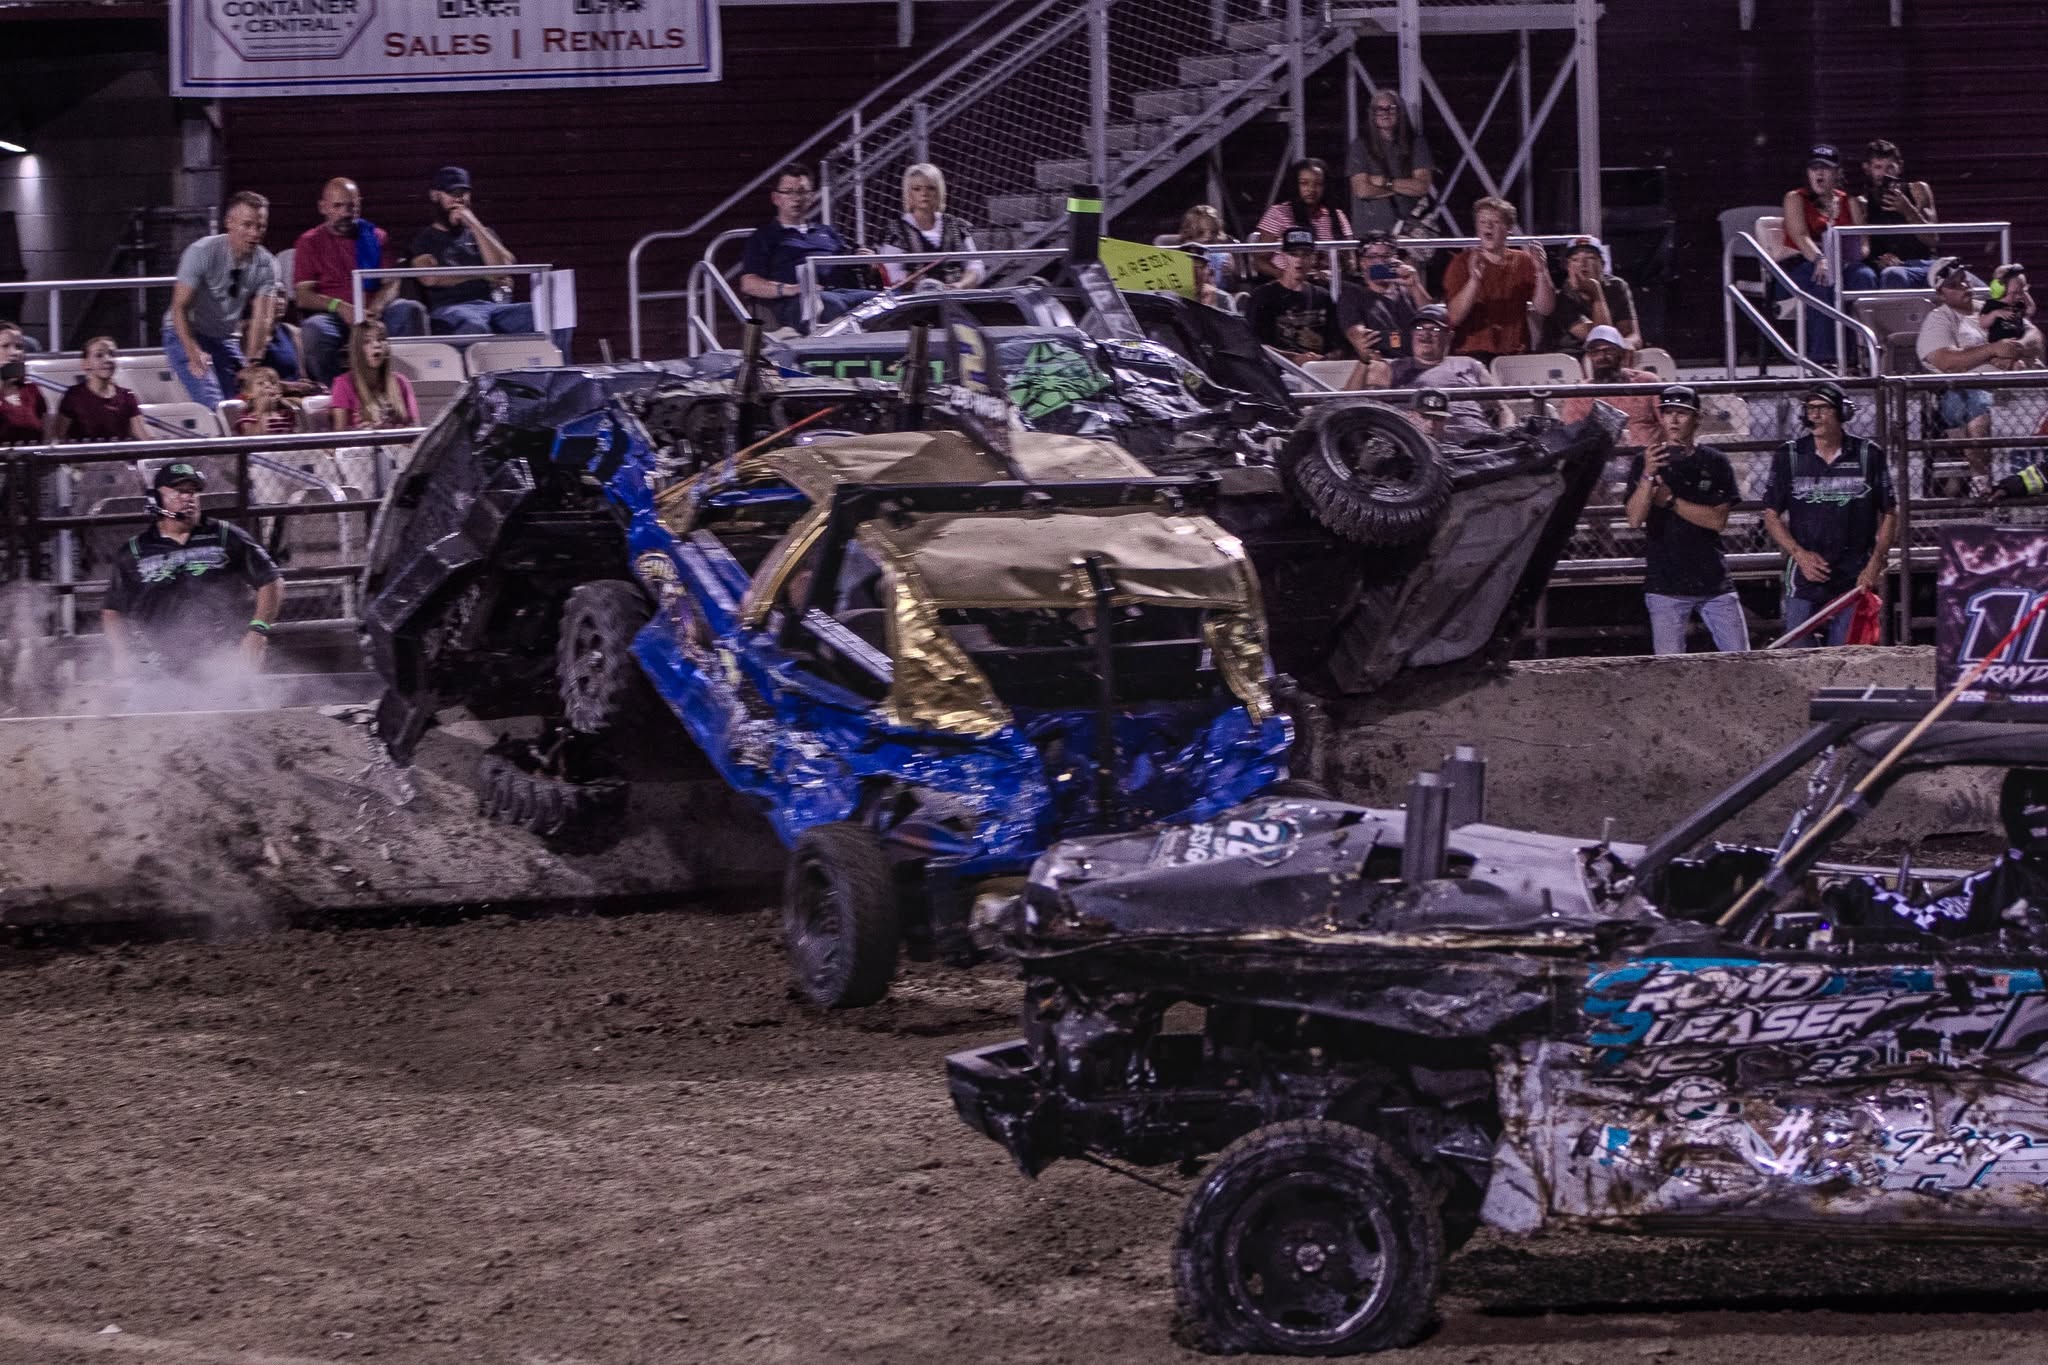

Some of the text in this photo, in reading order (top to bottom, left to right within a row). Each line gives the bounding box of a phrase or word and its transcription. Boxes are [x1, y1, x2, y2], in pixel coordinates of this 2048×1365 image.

[223, 0, 358, 16] CONTAINER
[245, 18, 340, 33] CENTRAL
[384, 32, 492, 57] SALES
[543, 28, 686, 53] RENTALS
